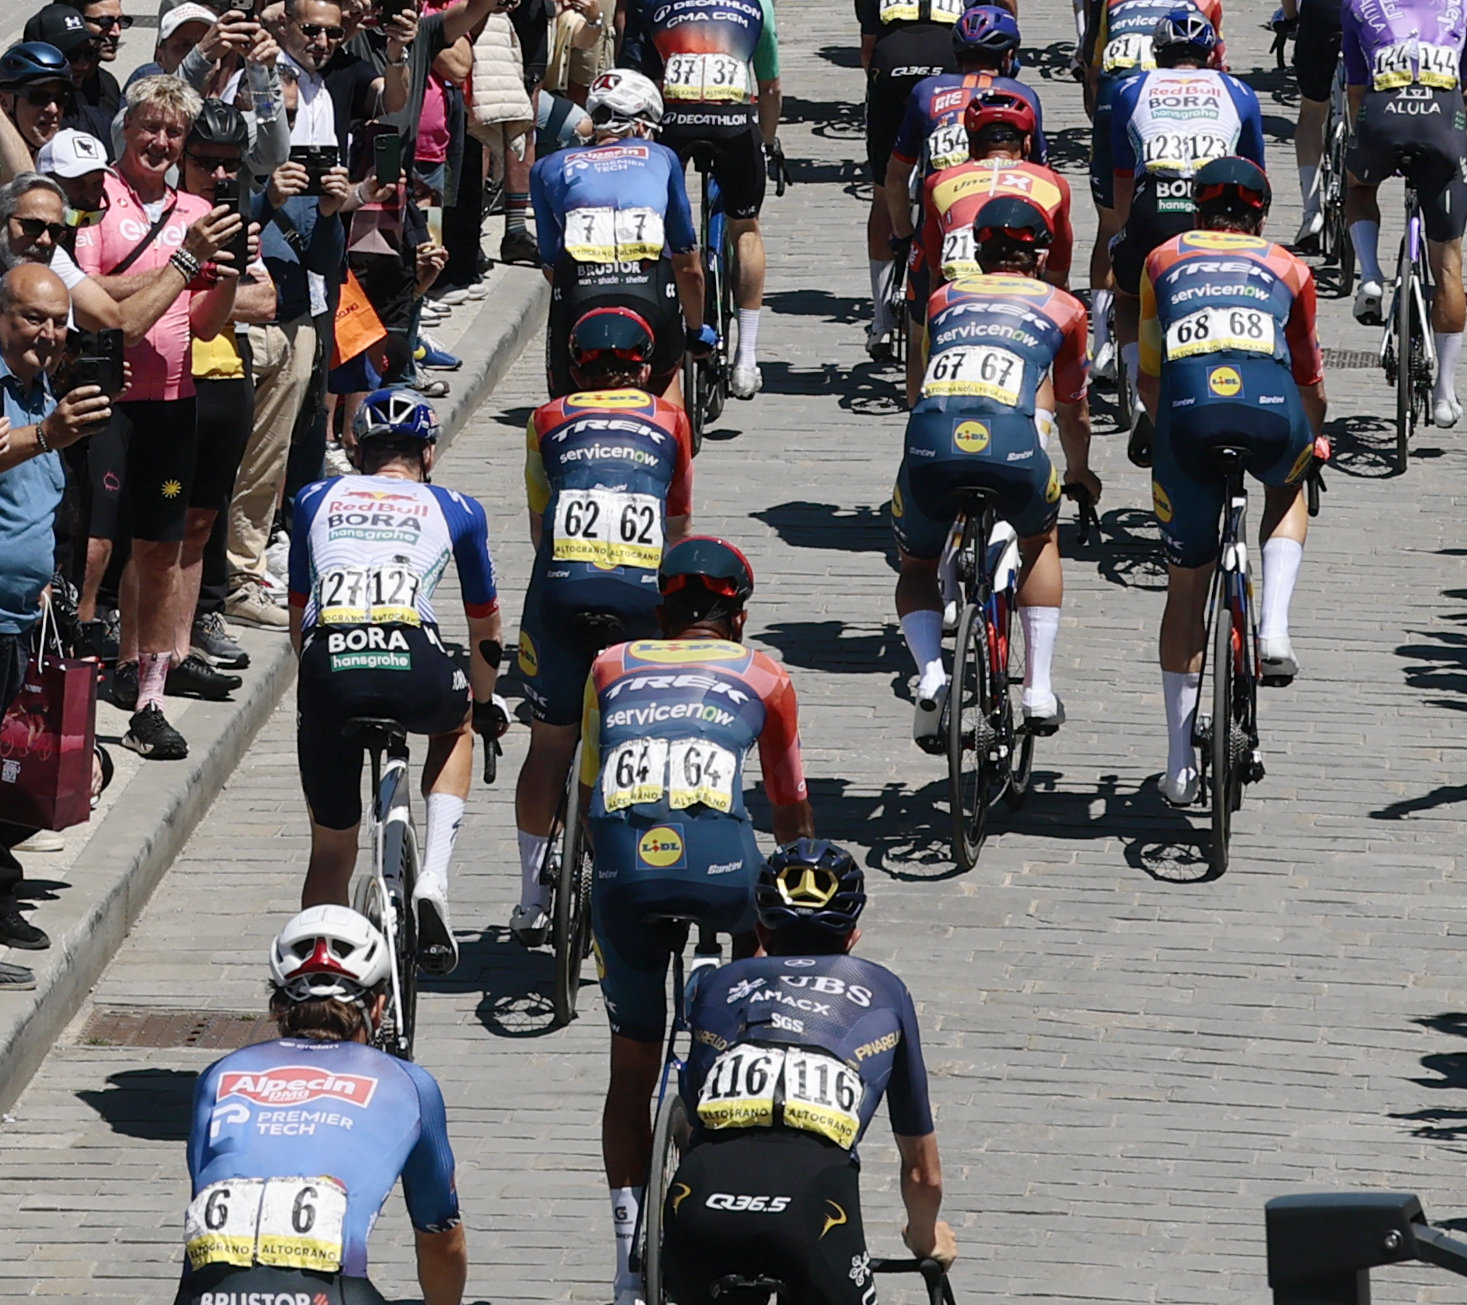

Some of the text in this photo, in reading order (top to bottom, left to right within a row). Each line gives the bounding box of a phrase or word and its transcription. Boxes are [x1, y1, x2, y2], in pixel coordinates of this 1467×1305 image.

[666, 11, 749, 29] CMA CGM
[1109, 38, 1130, 58] 61
[1375, 42, 1409, 76] 144
[1421, 44, 1457, 76] 144
[669, 59, 696, 85] 37
[713, 59, 739, 86] 37
[890, 66, 944, 77] Q36.5
[1148, 86, 1222, 99] Red Bull
[1148, 96, 1220, 109] BORA
[677, 113, 747, 126] DECATHLON
[1152, 108, 1218, 120] hansgrohe
[1384, 102, 1442, 114] ALULA
[574, 148, 639, 159] Alpecin
[932, 127, 969, 157] 154
[1143, 135, 1183, 161] 123
[1190, 135, 1228, 161] 123
[593, 159, 645, 168] PREMIER
[595, 165, 628, 173] TECH
[581, 214, 595, 243] 7
[633, 214, 647, 241] 7
[578, 275, 649, 286] sun shade shelter
[1165, 261, 1275, 285] TREK
[1170, 283, 1270, 306] servicenow
[934, 302, 1052, 332] TREK
[1177, 314, 1210, 344] 68
[1229, 311, 1263, 339] 68
[936, 321, 1040, 348] servicenow
[932, 352, 967, 381] 67
[980, 352, 1014, 387] 67
[551, 419, 667, 445] TREK
[559, 443, 660, 468] servicenow
[327, 513, 422, 532] BORA
[328, 501, 429, 518] Red Bull
[564, 500, 600, 539] 62
[330, 528, 416, 543] hansgrohe
[620, 504, 655, 545] 62
[555, 545, 608, 555] ALTOGRANO
[608, 549, 660, 561] ALTOGRANO
[328, 627, 410, 653] BORA
[331, 652, 410, 668] hansgrohe
[605, 674, 751, 705] TREK
[605, 702, 735, 729] servicenow
[616, 746, 650, 789] 64
[683, 747, 721, 788] 64
[707, 859, 744, 875] Santini
[749, 989, 831, 1017] AMACX
[779, 974, 873, 1008] UBS
[770, 1012, 805, 1033] SGS
[230, 1076, 356, 1097] Alpecin
[707, 1054, 771, 1101] 116
[792, 1058, 856, 1113] 116
[257, 1111, 354, 1130] PREMIER
[257, 1123, 316, 1136] TECH
[788, 1108, 852, 1137] ALTOGRANO
[204, 1188, 231, 1232] 6
[291, 1186, 319, 1235] 6
[705, 1193, 792, 1214] Q36.5
[261, 1243, 338, 1262] ALTOGRANO
